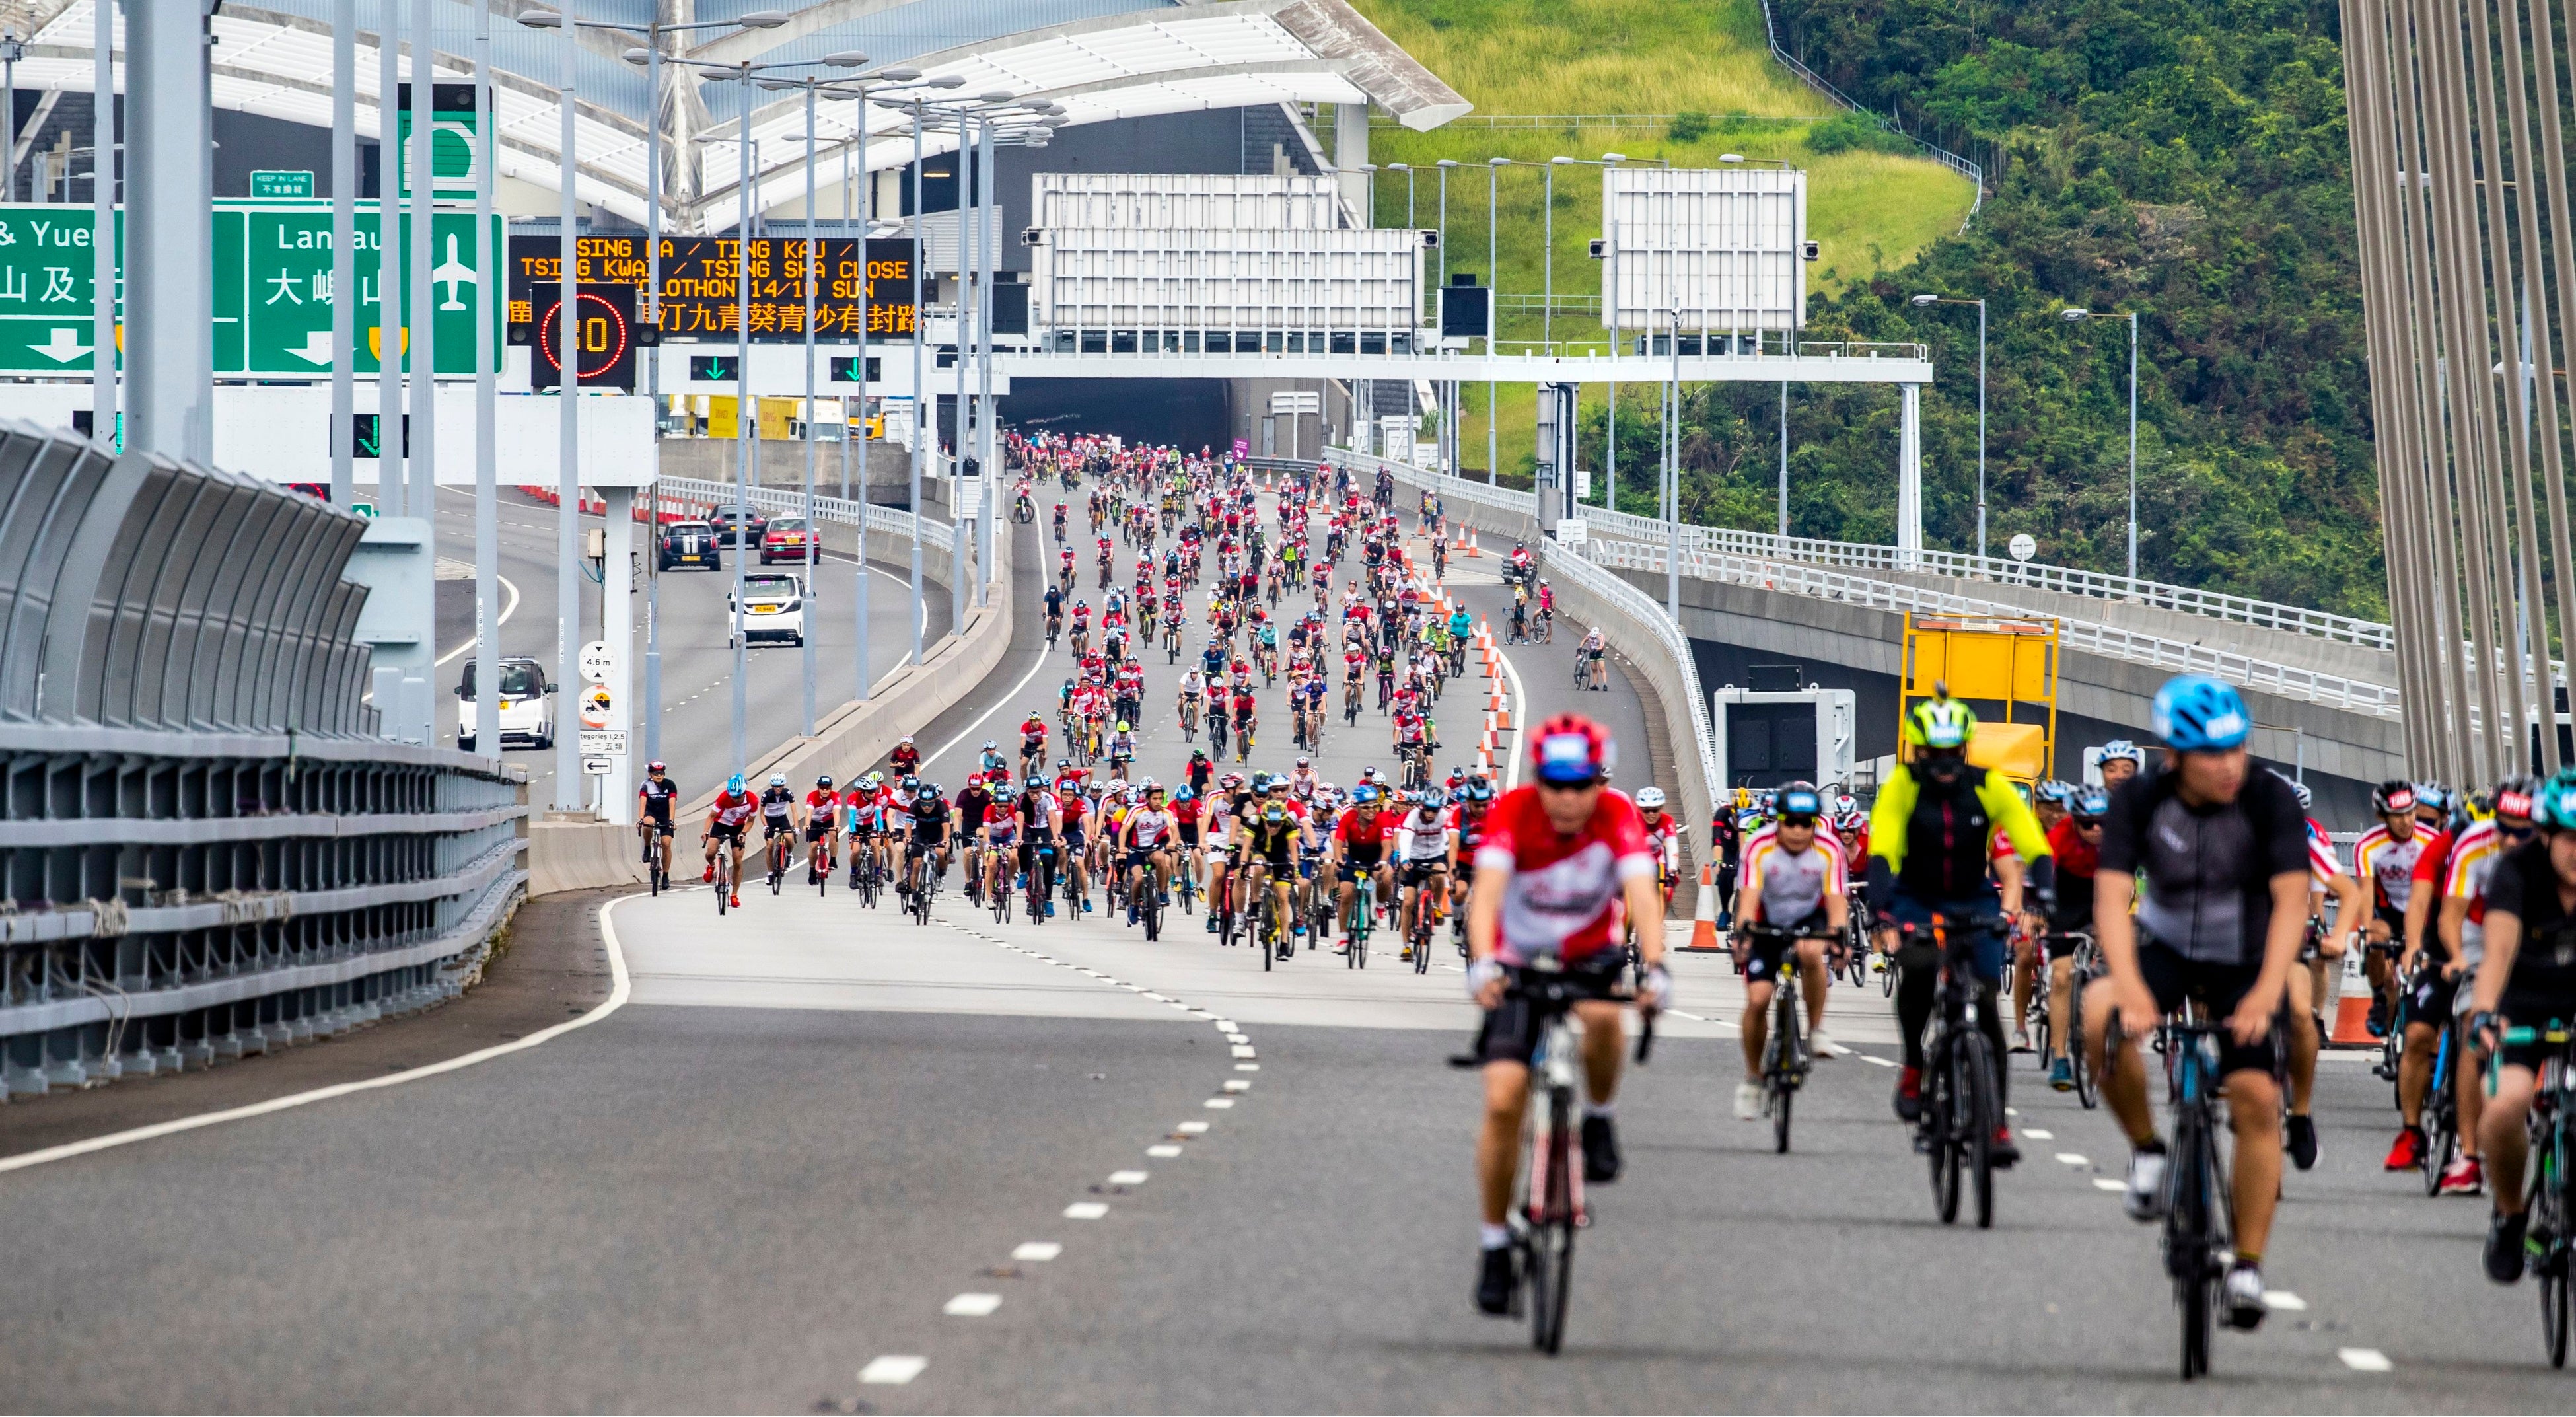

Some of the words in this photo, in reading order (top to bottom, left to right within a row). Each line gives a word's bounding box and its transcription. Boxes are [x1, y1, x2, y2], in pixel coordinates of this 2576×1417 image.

[30, 221, 94, 247] Yue
[279, 224, 381, 250] Lanau
[577, 239, 632, 257] SING
[715, 240, 770, 258] TING
[784, 241, 825, 258] KAU
[521, 258, 590, 276] TSIG
[701, 260, 770, 278] TSING
[784, 261, 825, 278] SHA
[832, 281, 873, 299] SUN
